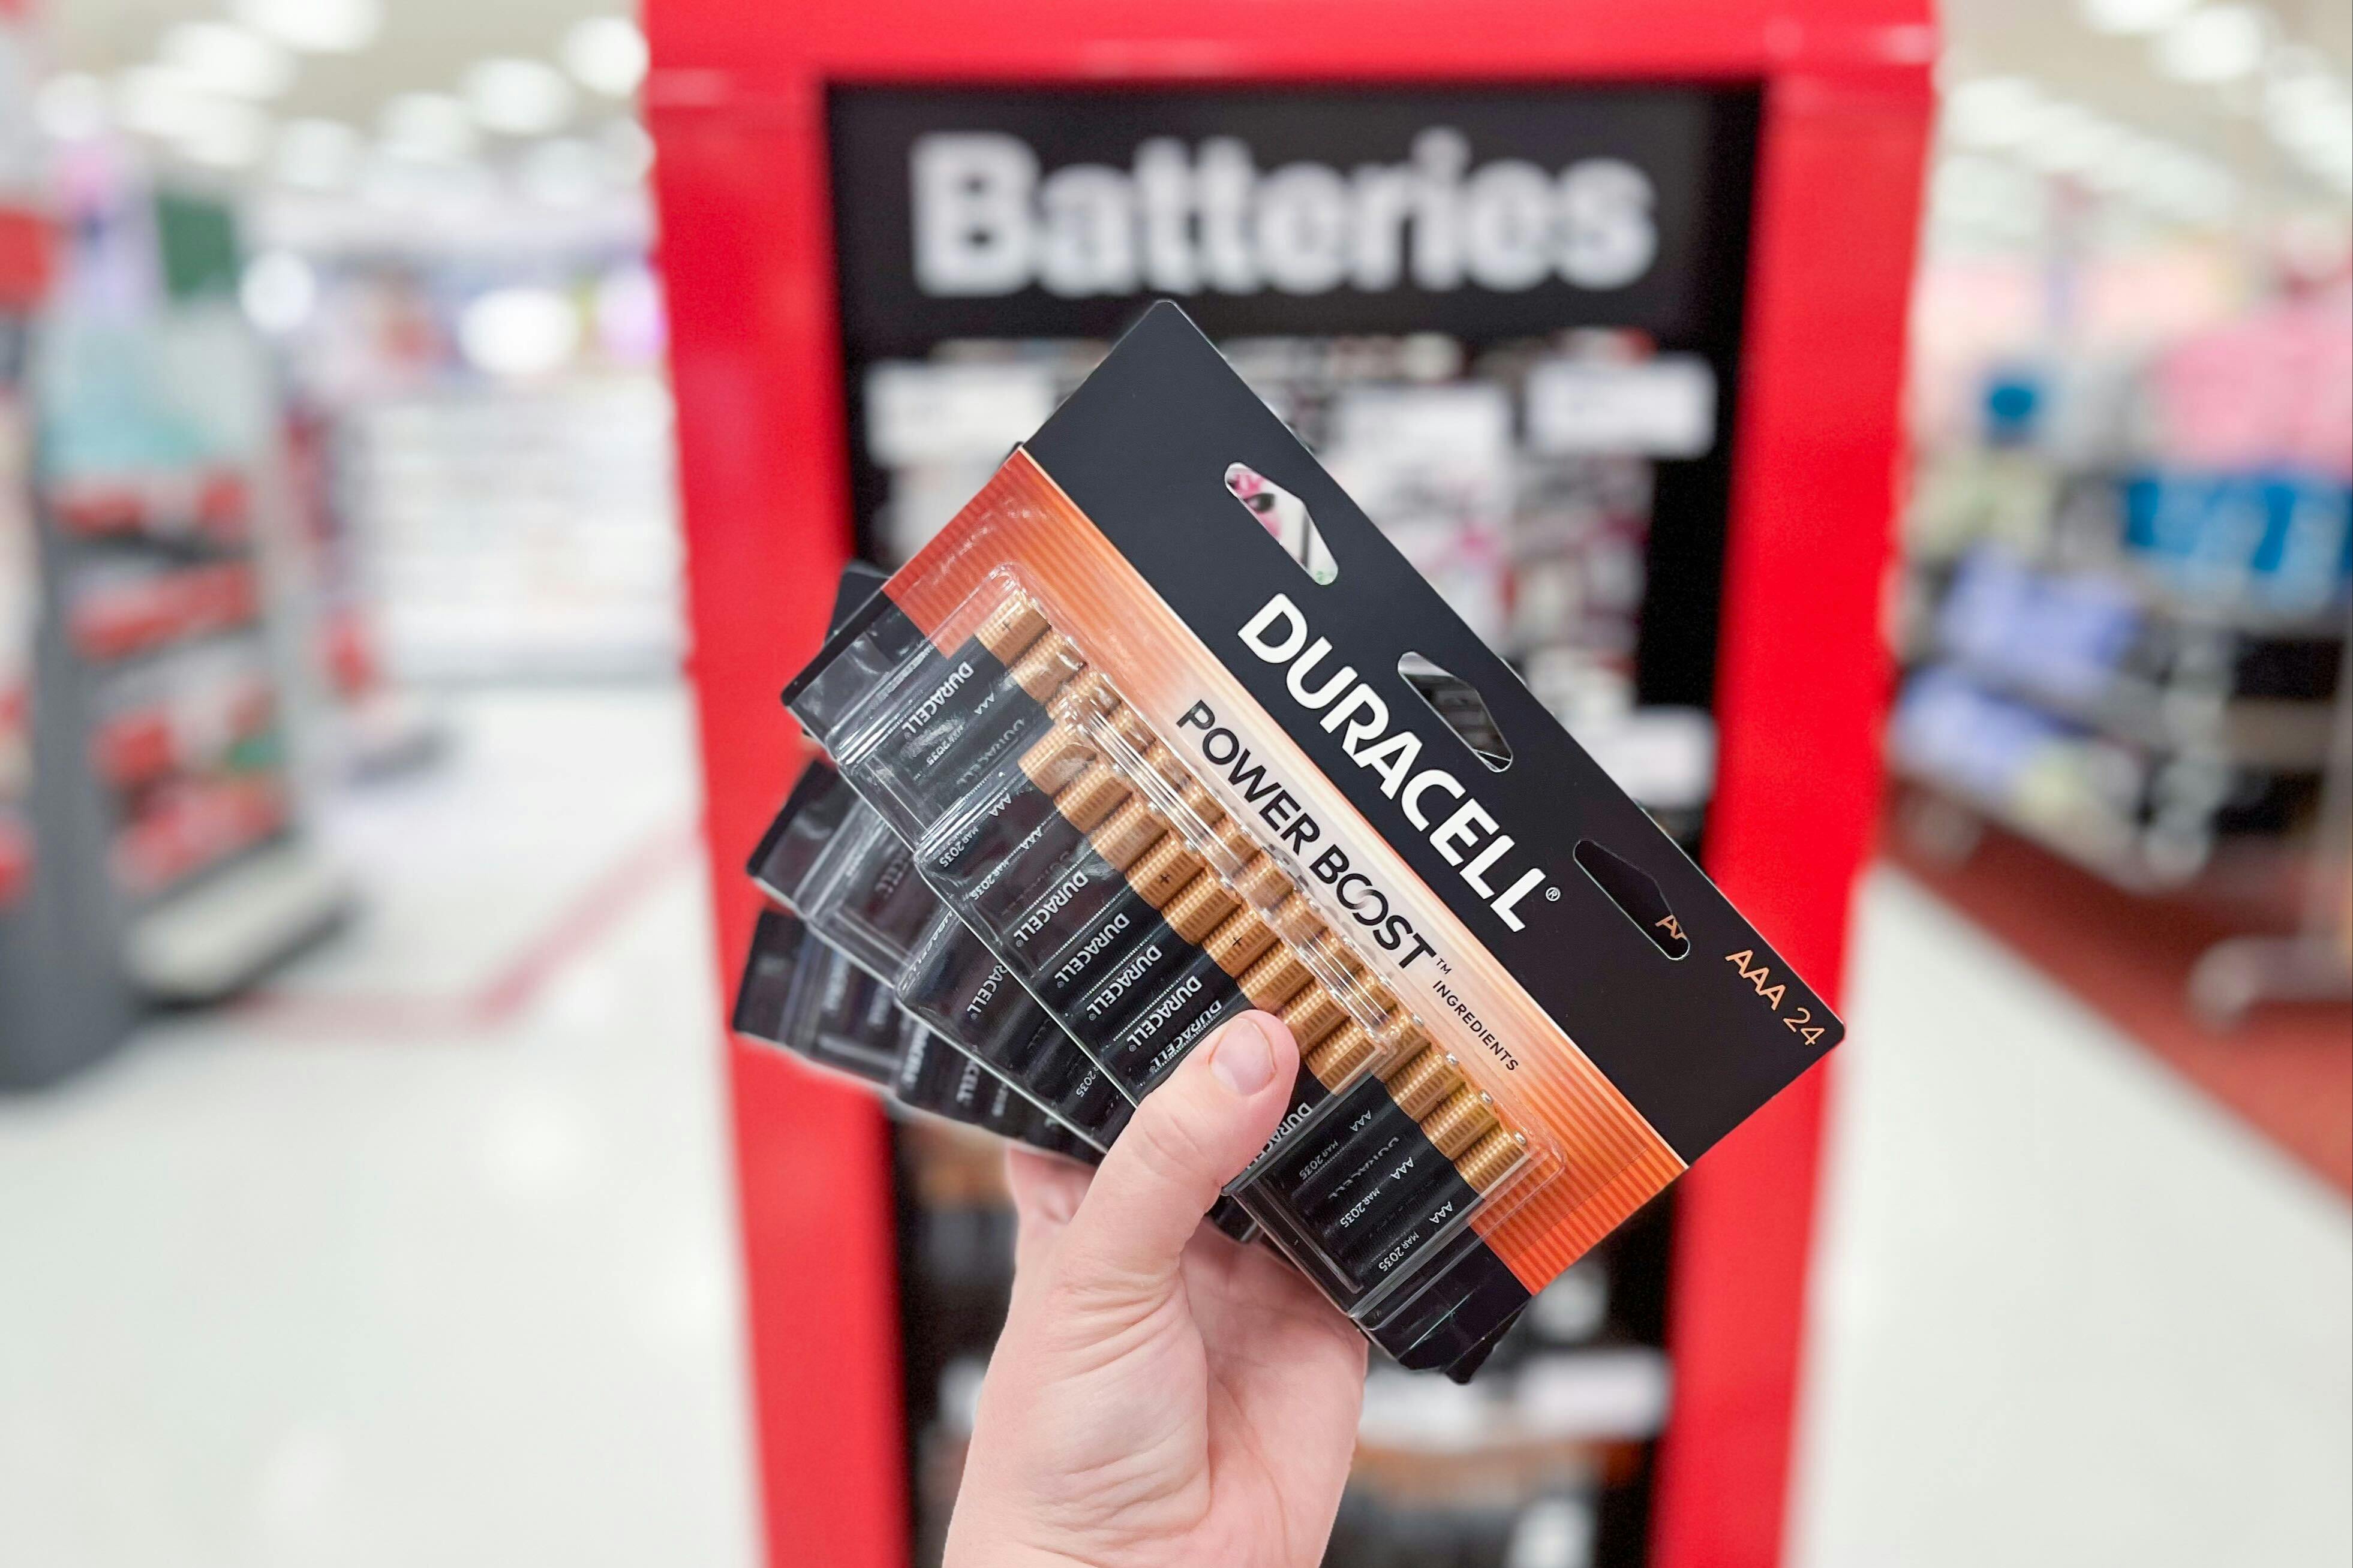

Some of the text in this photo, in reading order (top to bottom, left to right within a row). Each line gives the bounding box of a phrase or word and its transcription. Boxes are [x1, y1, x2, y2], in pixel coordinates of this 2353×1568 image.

[909, 128, 1657, 298] Batteries
[974, 692, 994, 715] AAA
[1176, 699, 1320, 855] POWER
[989, 793, 1012, 817] AAA
[939, 826, 979, 867] MAR 2035
[970, 873, 996, 900] 2035
[1725, 949, 1825, 1045] AAA 24
[1433, 980, 1519, 1072] INGREDIENTS
[1076, 1070, 1096, 1098] 2035
[1350, 1110, 1371, 1131] AAA
[1299, 1140, 1339, 1180] MAR 2035
[1390, 1156, 1414, 1179] AAA
[1339, 1187, 1380, 1228] MAR 2035
[1429, 1201, 1453, 1223] AAA
[1378, 1230, 1420, 1272] MAR 2035
